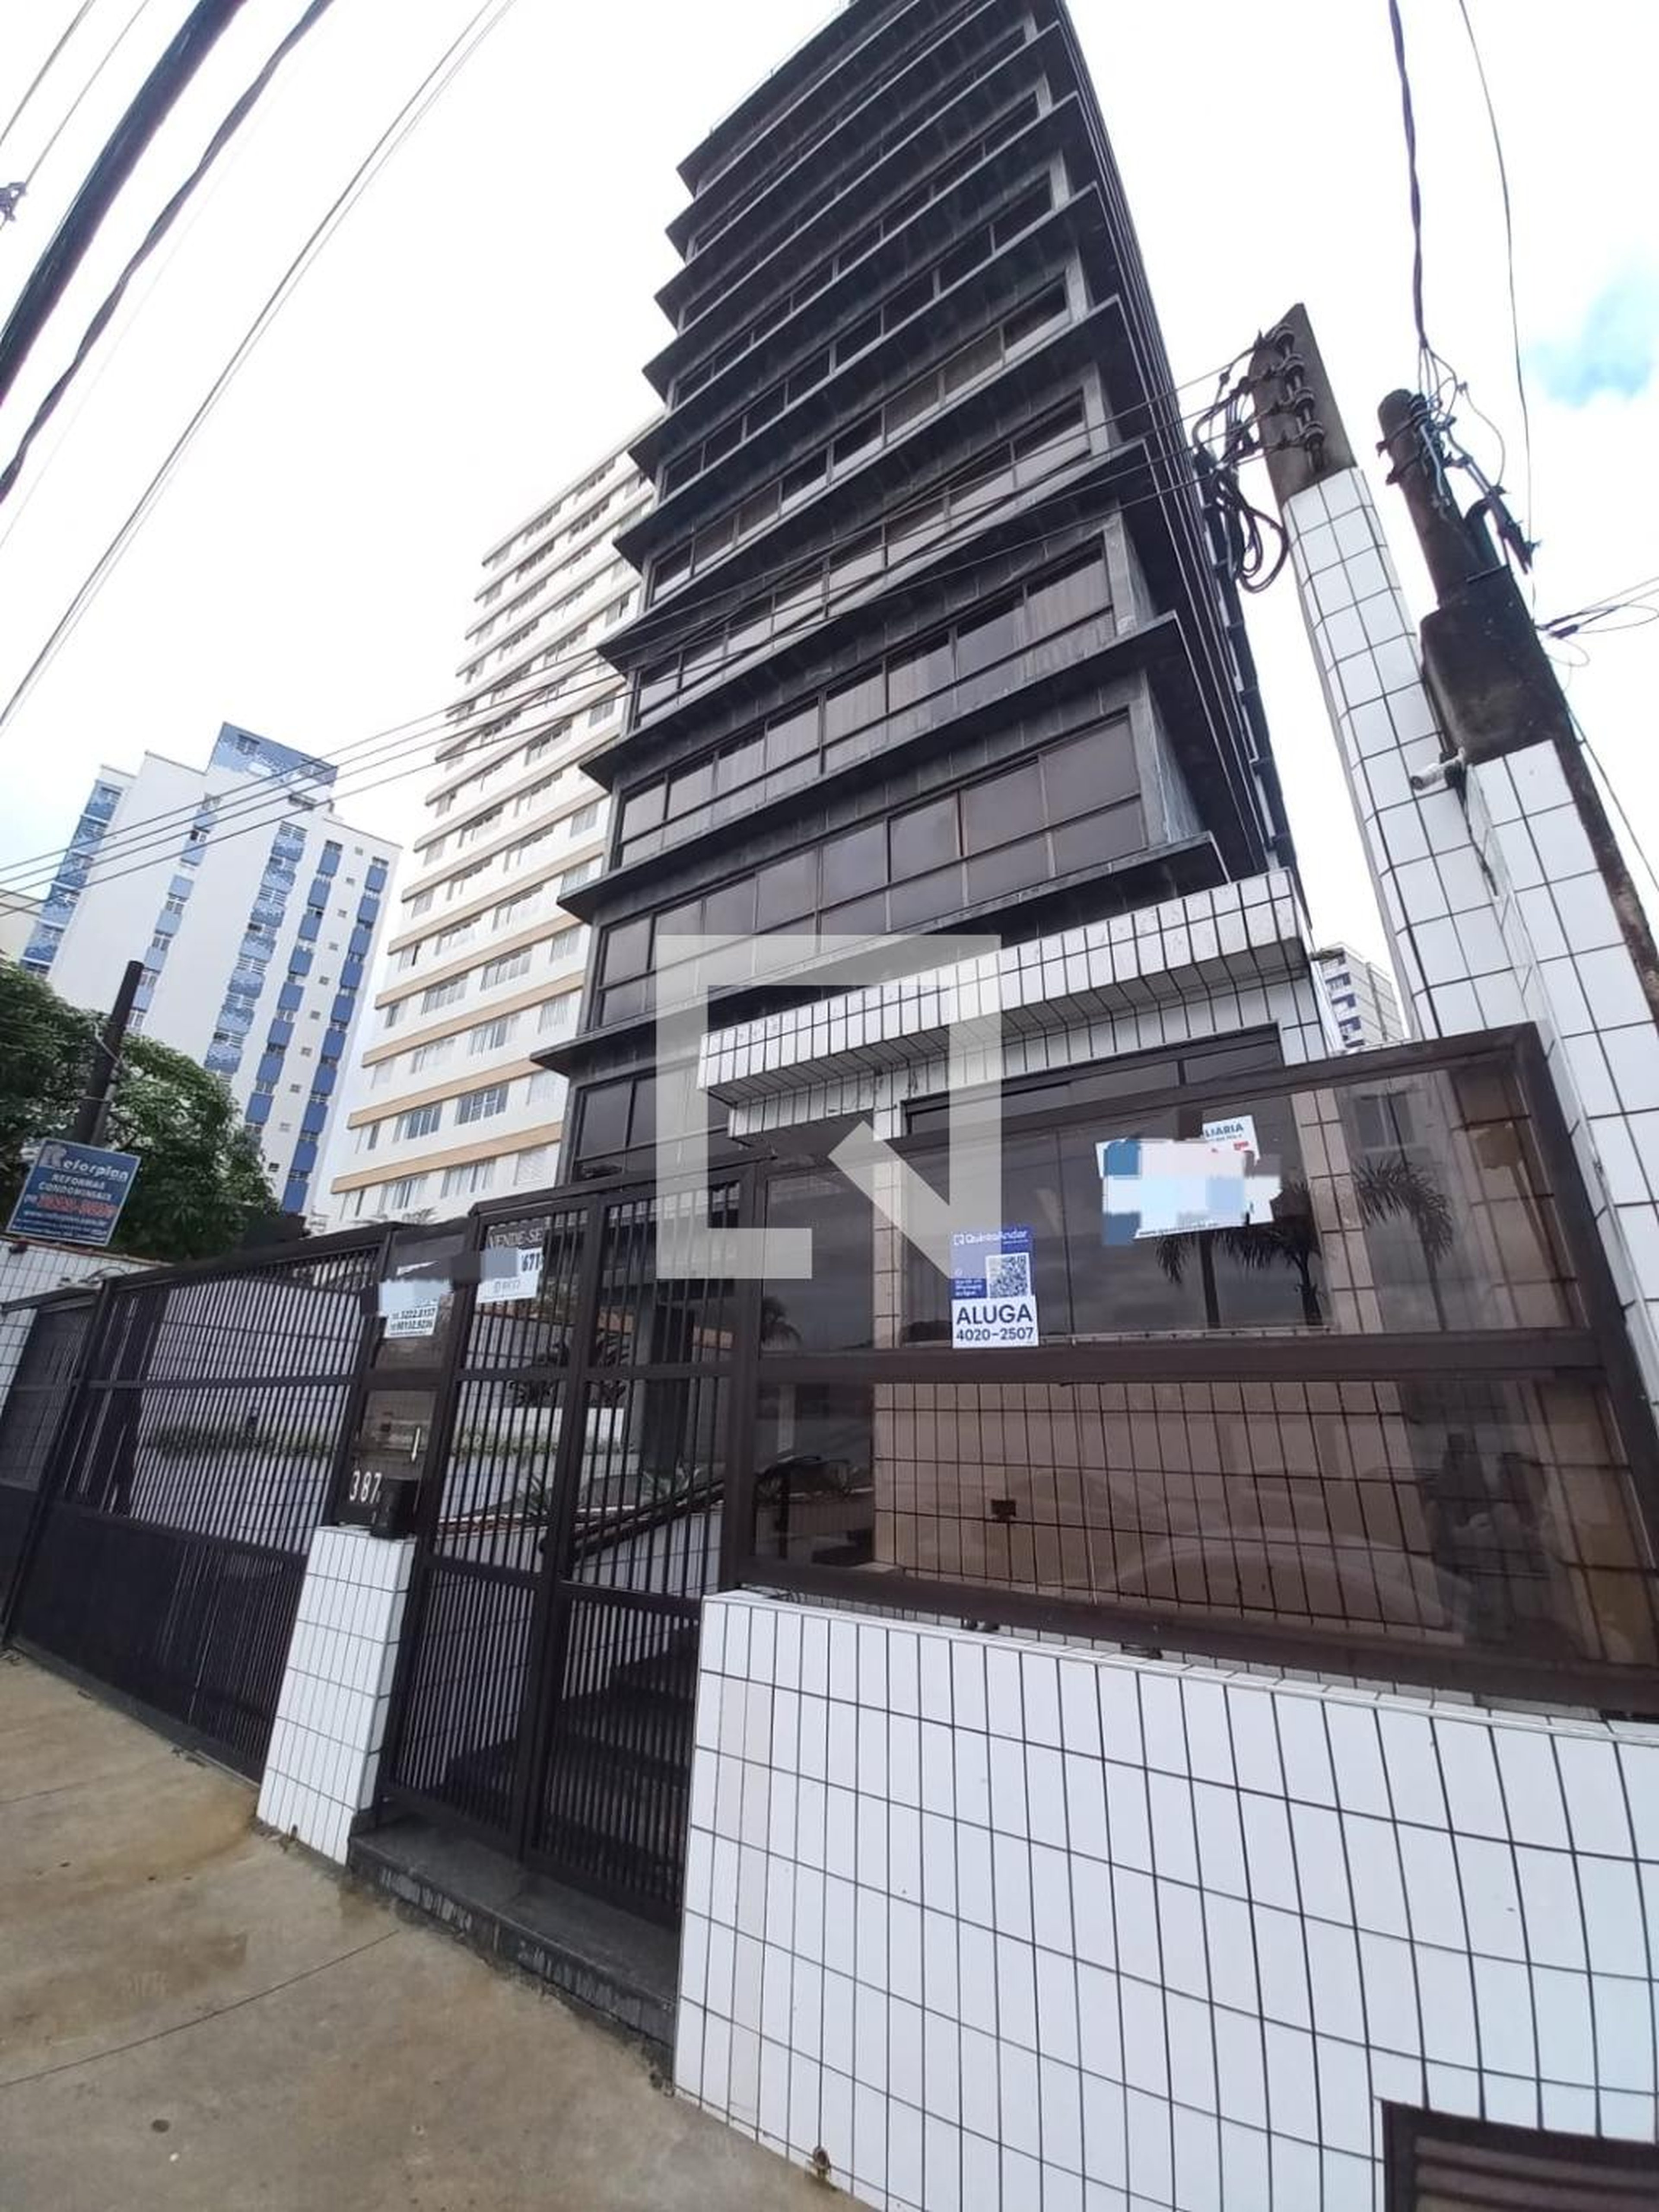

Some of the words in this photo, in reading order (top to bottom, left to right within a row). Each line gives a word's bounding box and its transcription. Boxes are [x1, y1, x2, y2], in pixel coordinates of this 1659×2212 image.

[51, 1173, 105, 1190] REFORMAS
[957, 1304, 1033, 1325] ALUGA
[956, 1327, 1034, 1341] 4020-2507
[350, 1470, 382, 1504] 387
